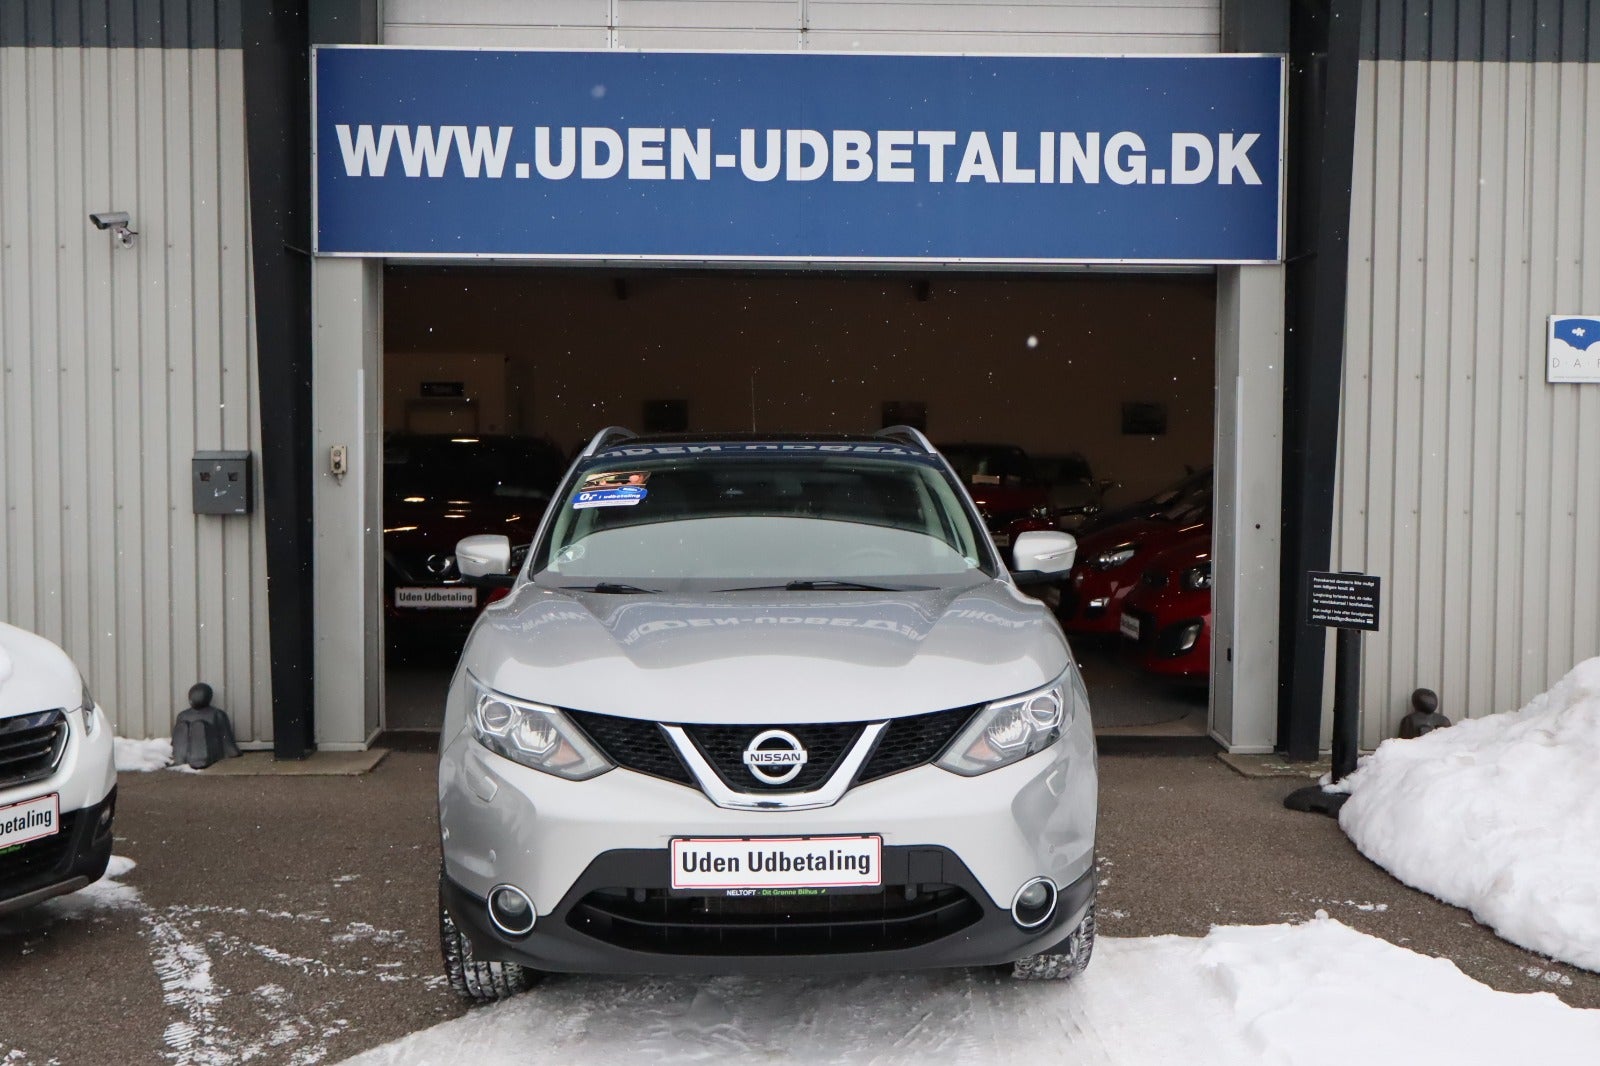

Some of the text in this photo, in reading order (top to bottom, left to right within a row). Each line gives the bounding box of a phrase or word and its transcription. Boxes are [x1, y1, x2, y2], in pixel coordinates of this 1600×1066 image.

[335, 124, 1263, 186] WWW.UDEN-UDBETALING.DK
[399, 592, 473, 603] Uden Udbetaling
[750, 753, 801, 762] NISSAN
[682, 849, 871, 875] Uden Udbetaling
